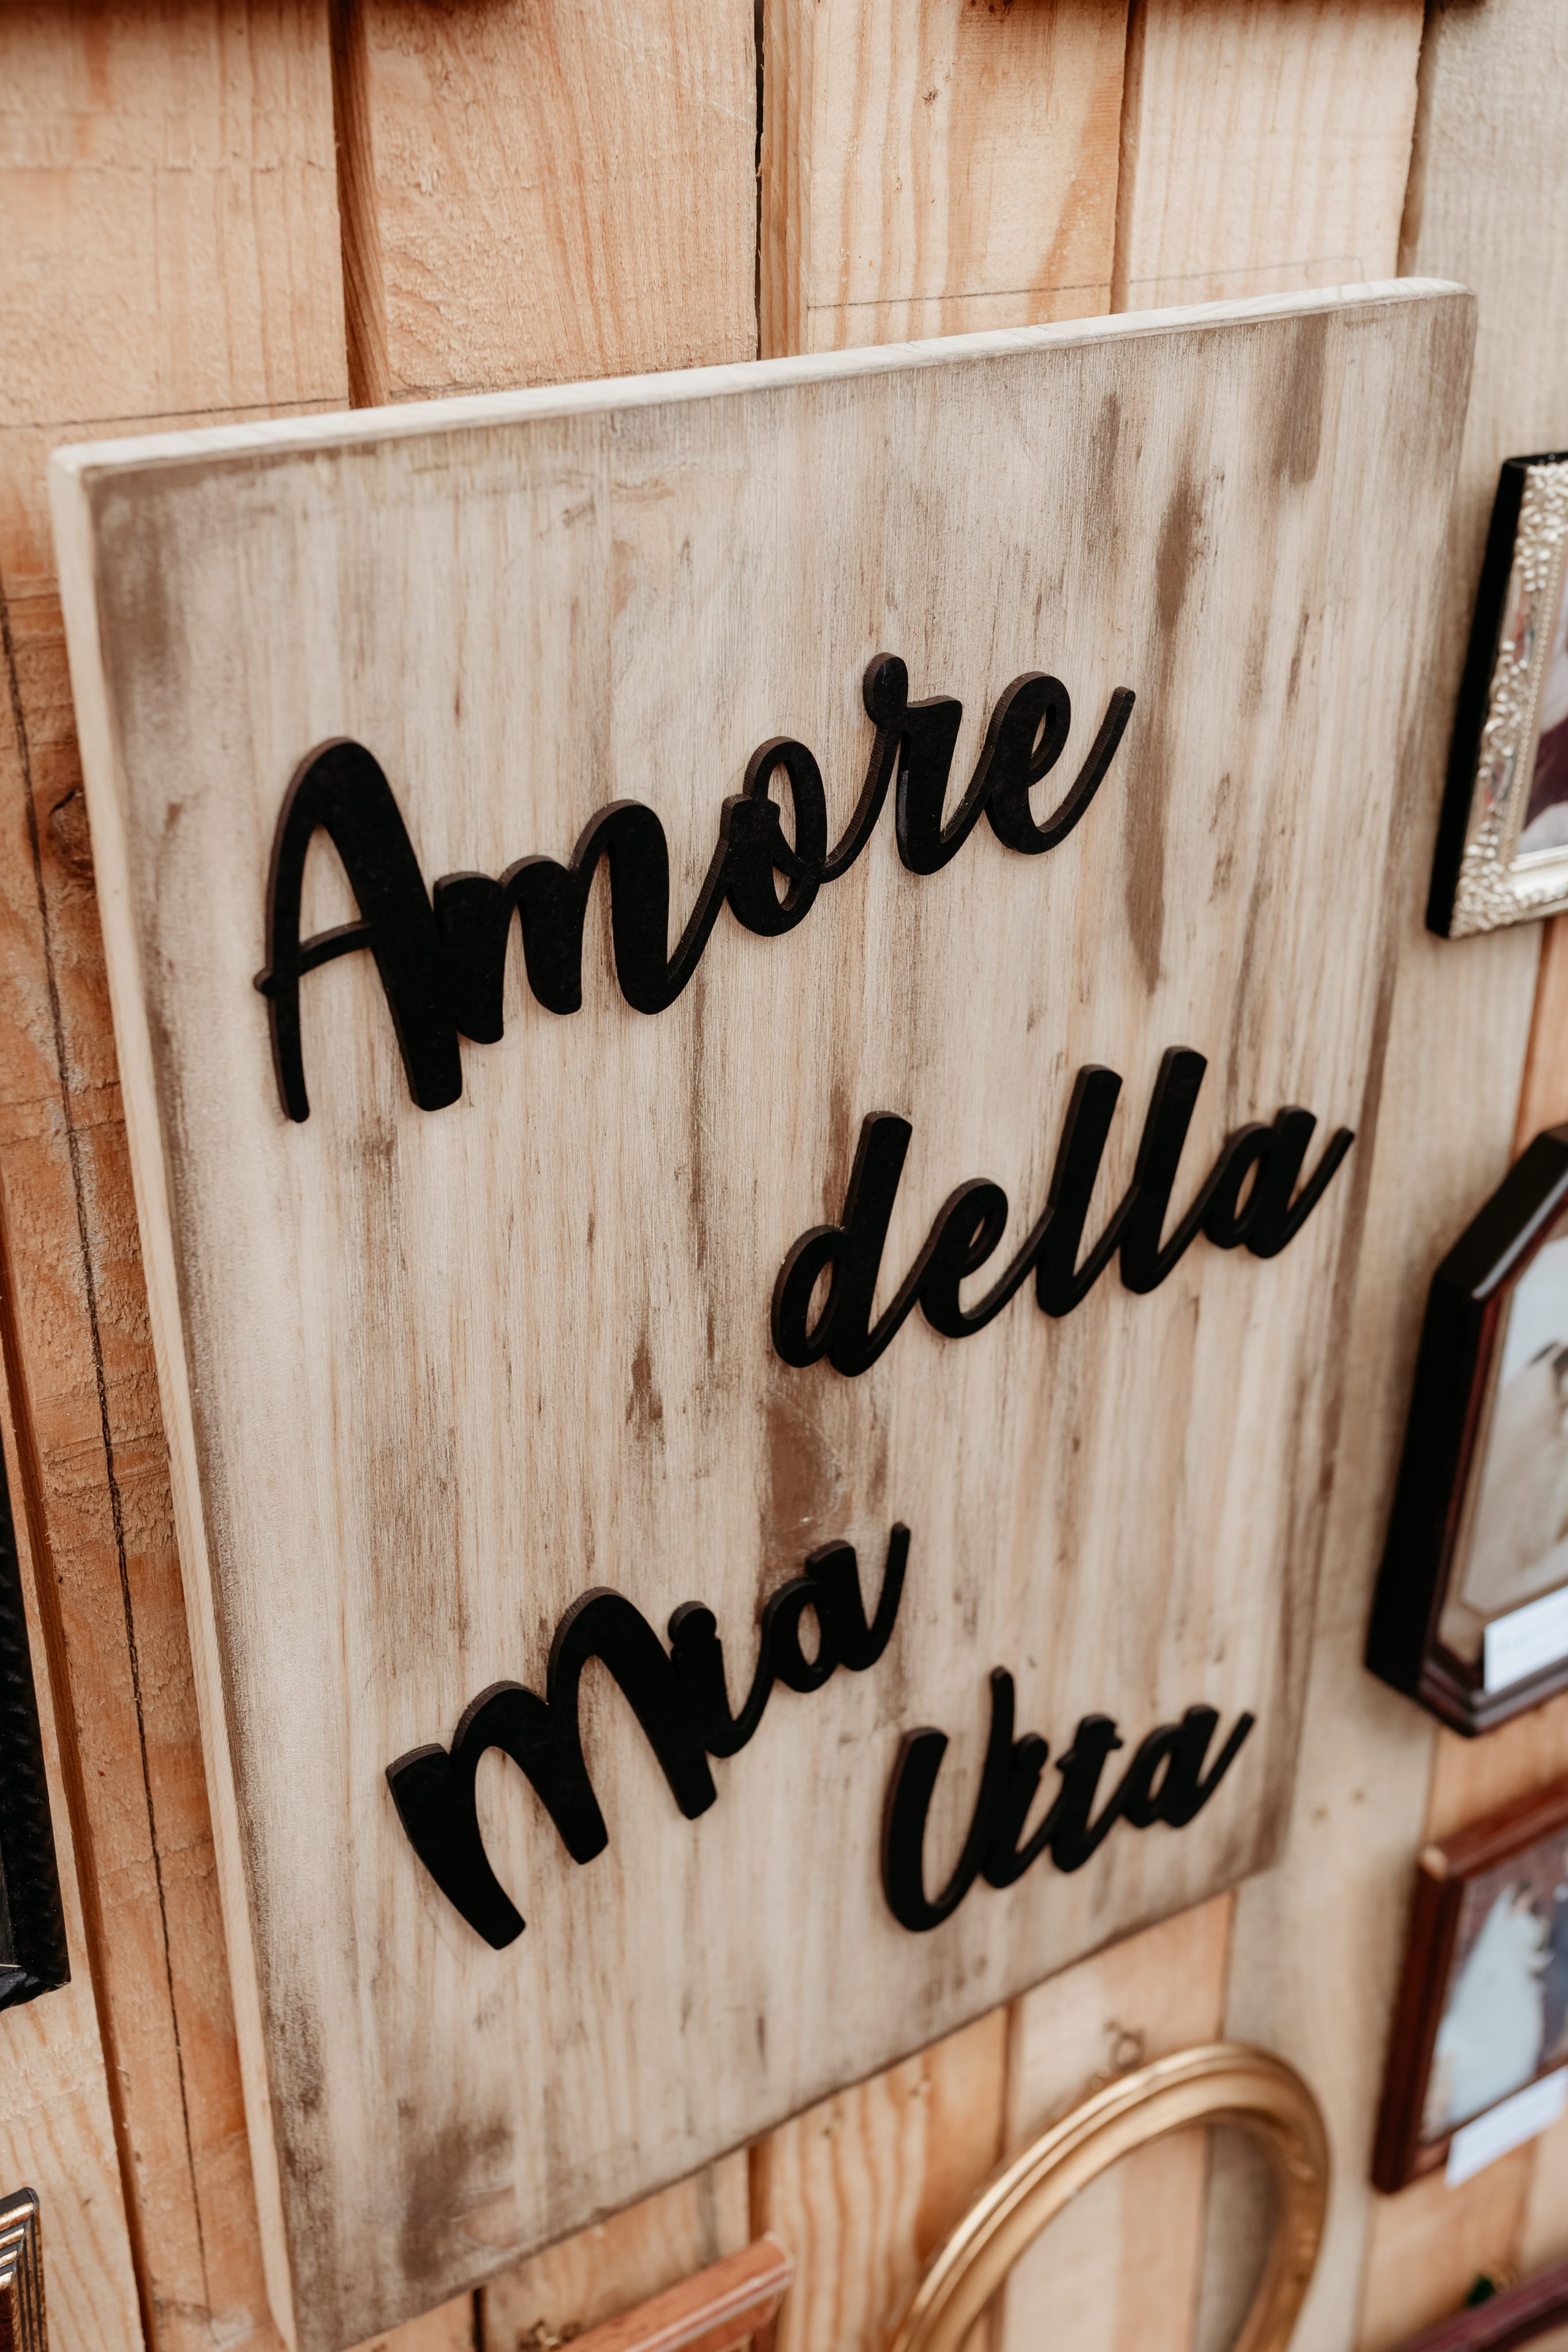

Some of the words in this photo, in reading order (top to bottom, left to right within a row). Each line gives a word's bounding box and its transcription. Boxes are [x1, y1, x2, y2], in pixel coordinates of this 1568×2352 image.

[254, 654, 1135, 1122] Amore
[772, 1049, 1355, 1377] della
[386, 1523, 910, 1949] Mia
[881, 1667, 1254, 1931] Vita
